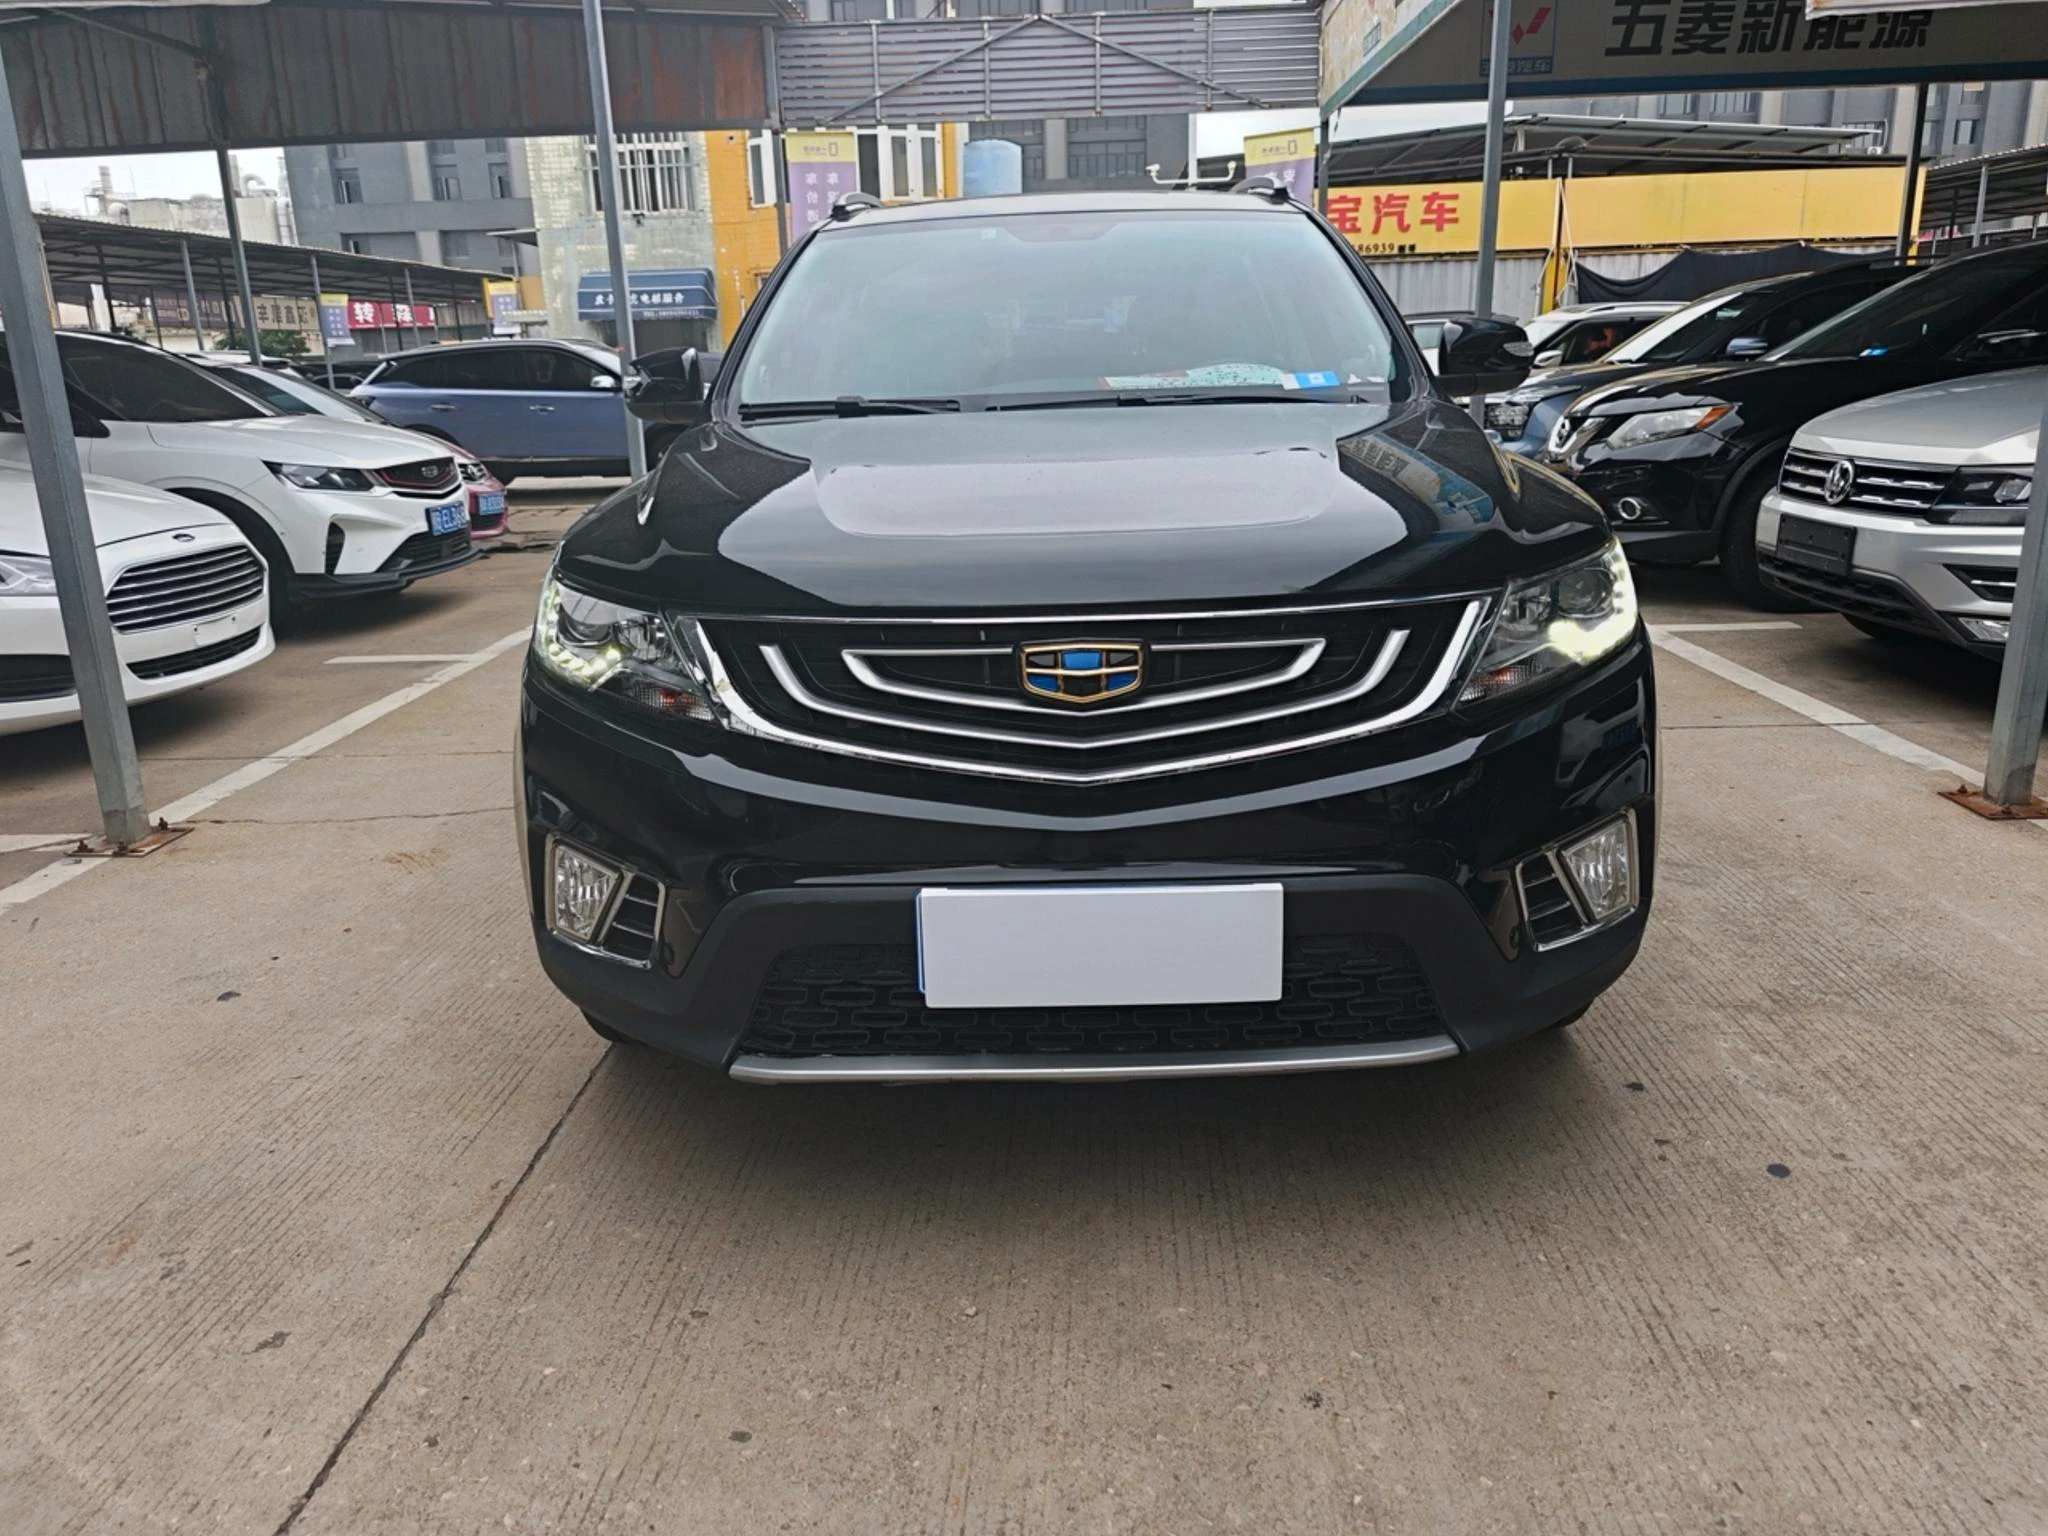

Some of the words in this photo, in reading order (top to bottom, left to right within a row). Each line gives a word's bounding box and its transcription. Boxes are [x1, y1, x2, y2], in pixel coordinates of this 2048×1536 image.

[1604, 0, 1933, 57] 五菱新能源
